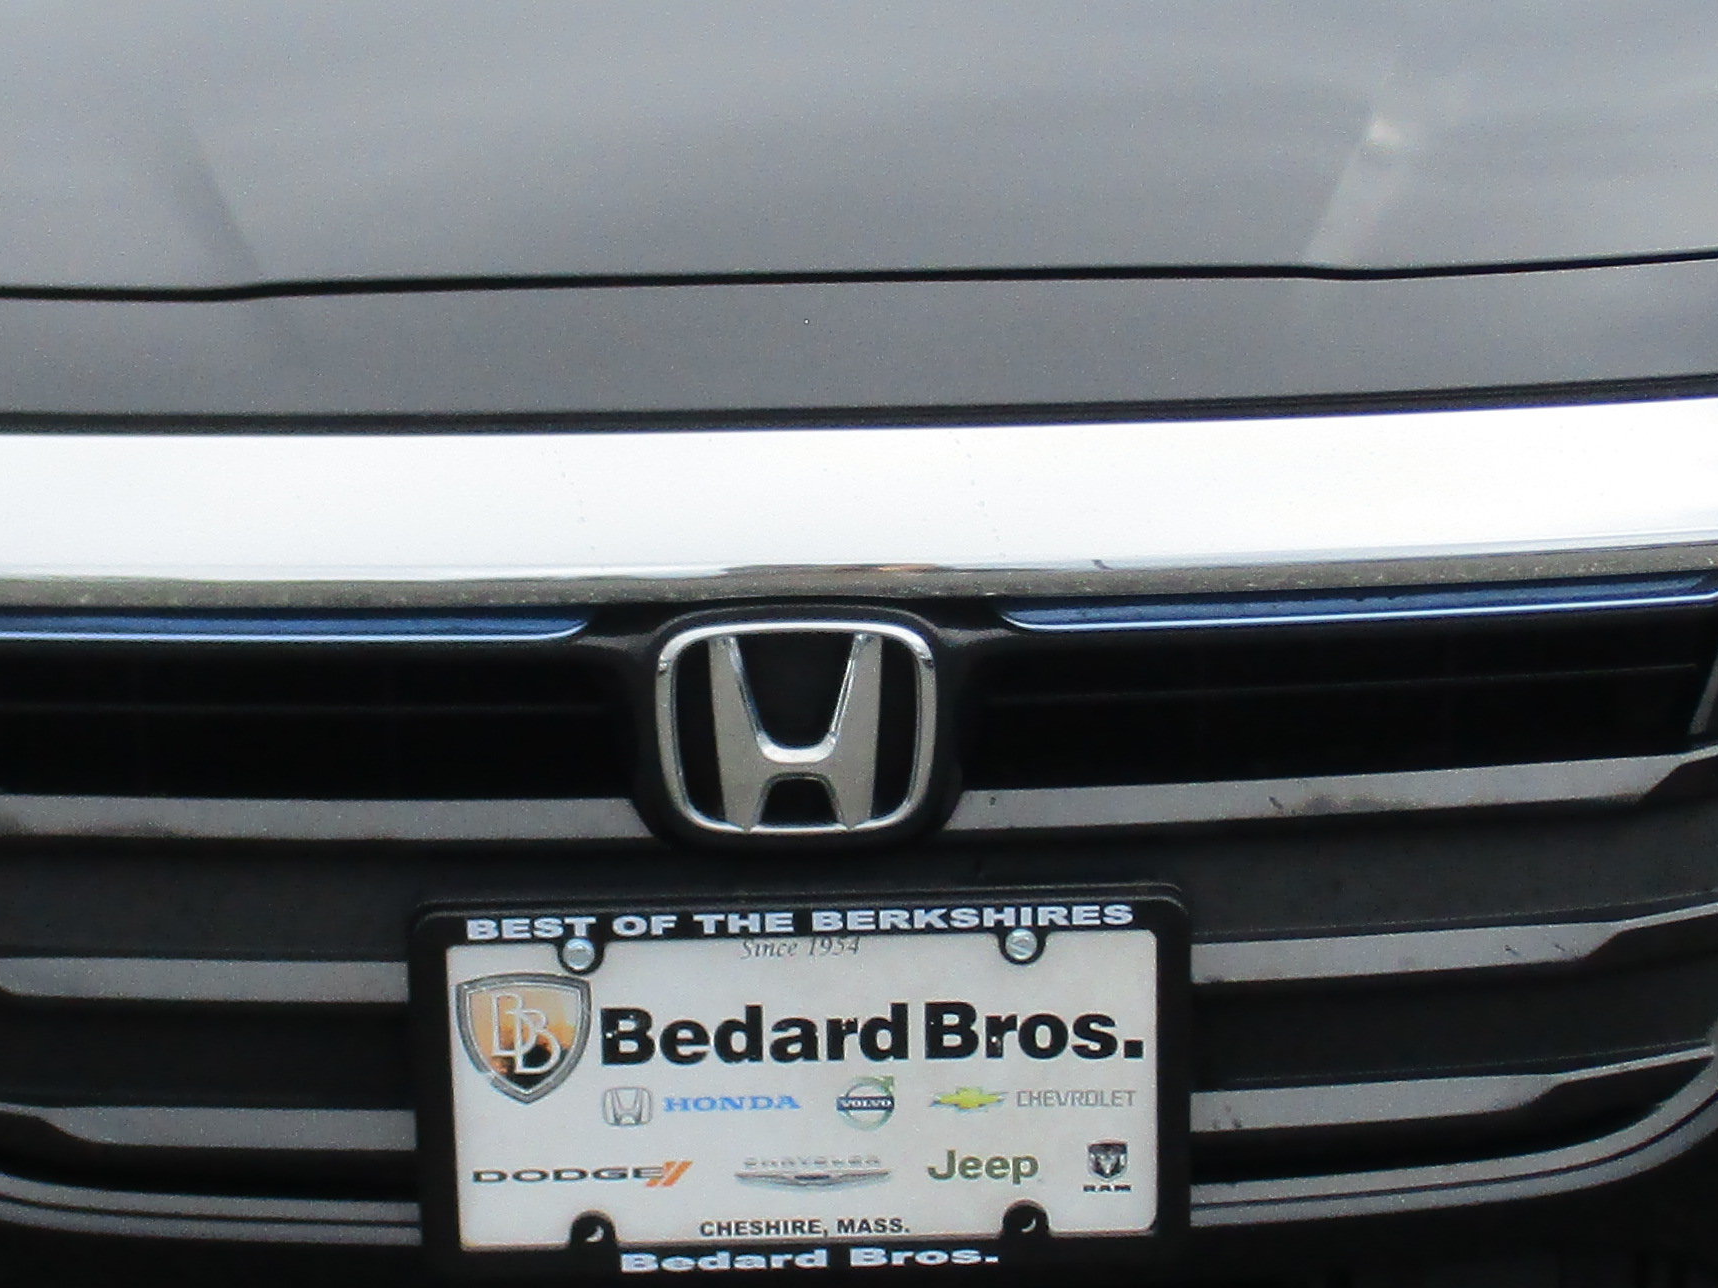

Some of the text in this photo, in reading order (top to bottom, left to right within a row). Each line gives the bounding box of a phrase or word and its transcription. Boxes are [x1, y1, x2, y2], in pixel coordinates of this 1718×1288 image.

[466, 904, 1134, 941] BEST OF THE BERKSHIRES
[740, 935, 860, 960] Since 1954
[600, 1001, 1144, 1066] Bedard Bros.
[663, 1096, 802, 1112] HONDA
[840, 1098, 893, 1109] VOLVO
[1016, 1089, 1136, 1108] CHEVROLET
[472, 1168, 664, 1183] DODGE
[927, 1149, 1039, 1185] Jeep
[1083, 1184, 1131, 1192] RAM
[699, 1217, 911, 1237] CHESHIRE, MASS.
[620, 1246, 999, 1273] Bedard Bros.
